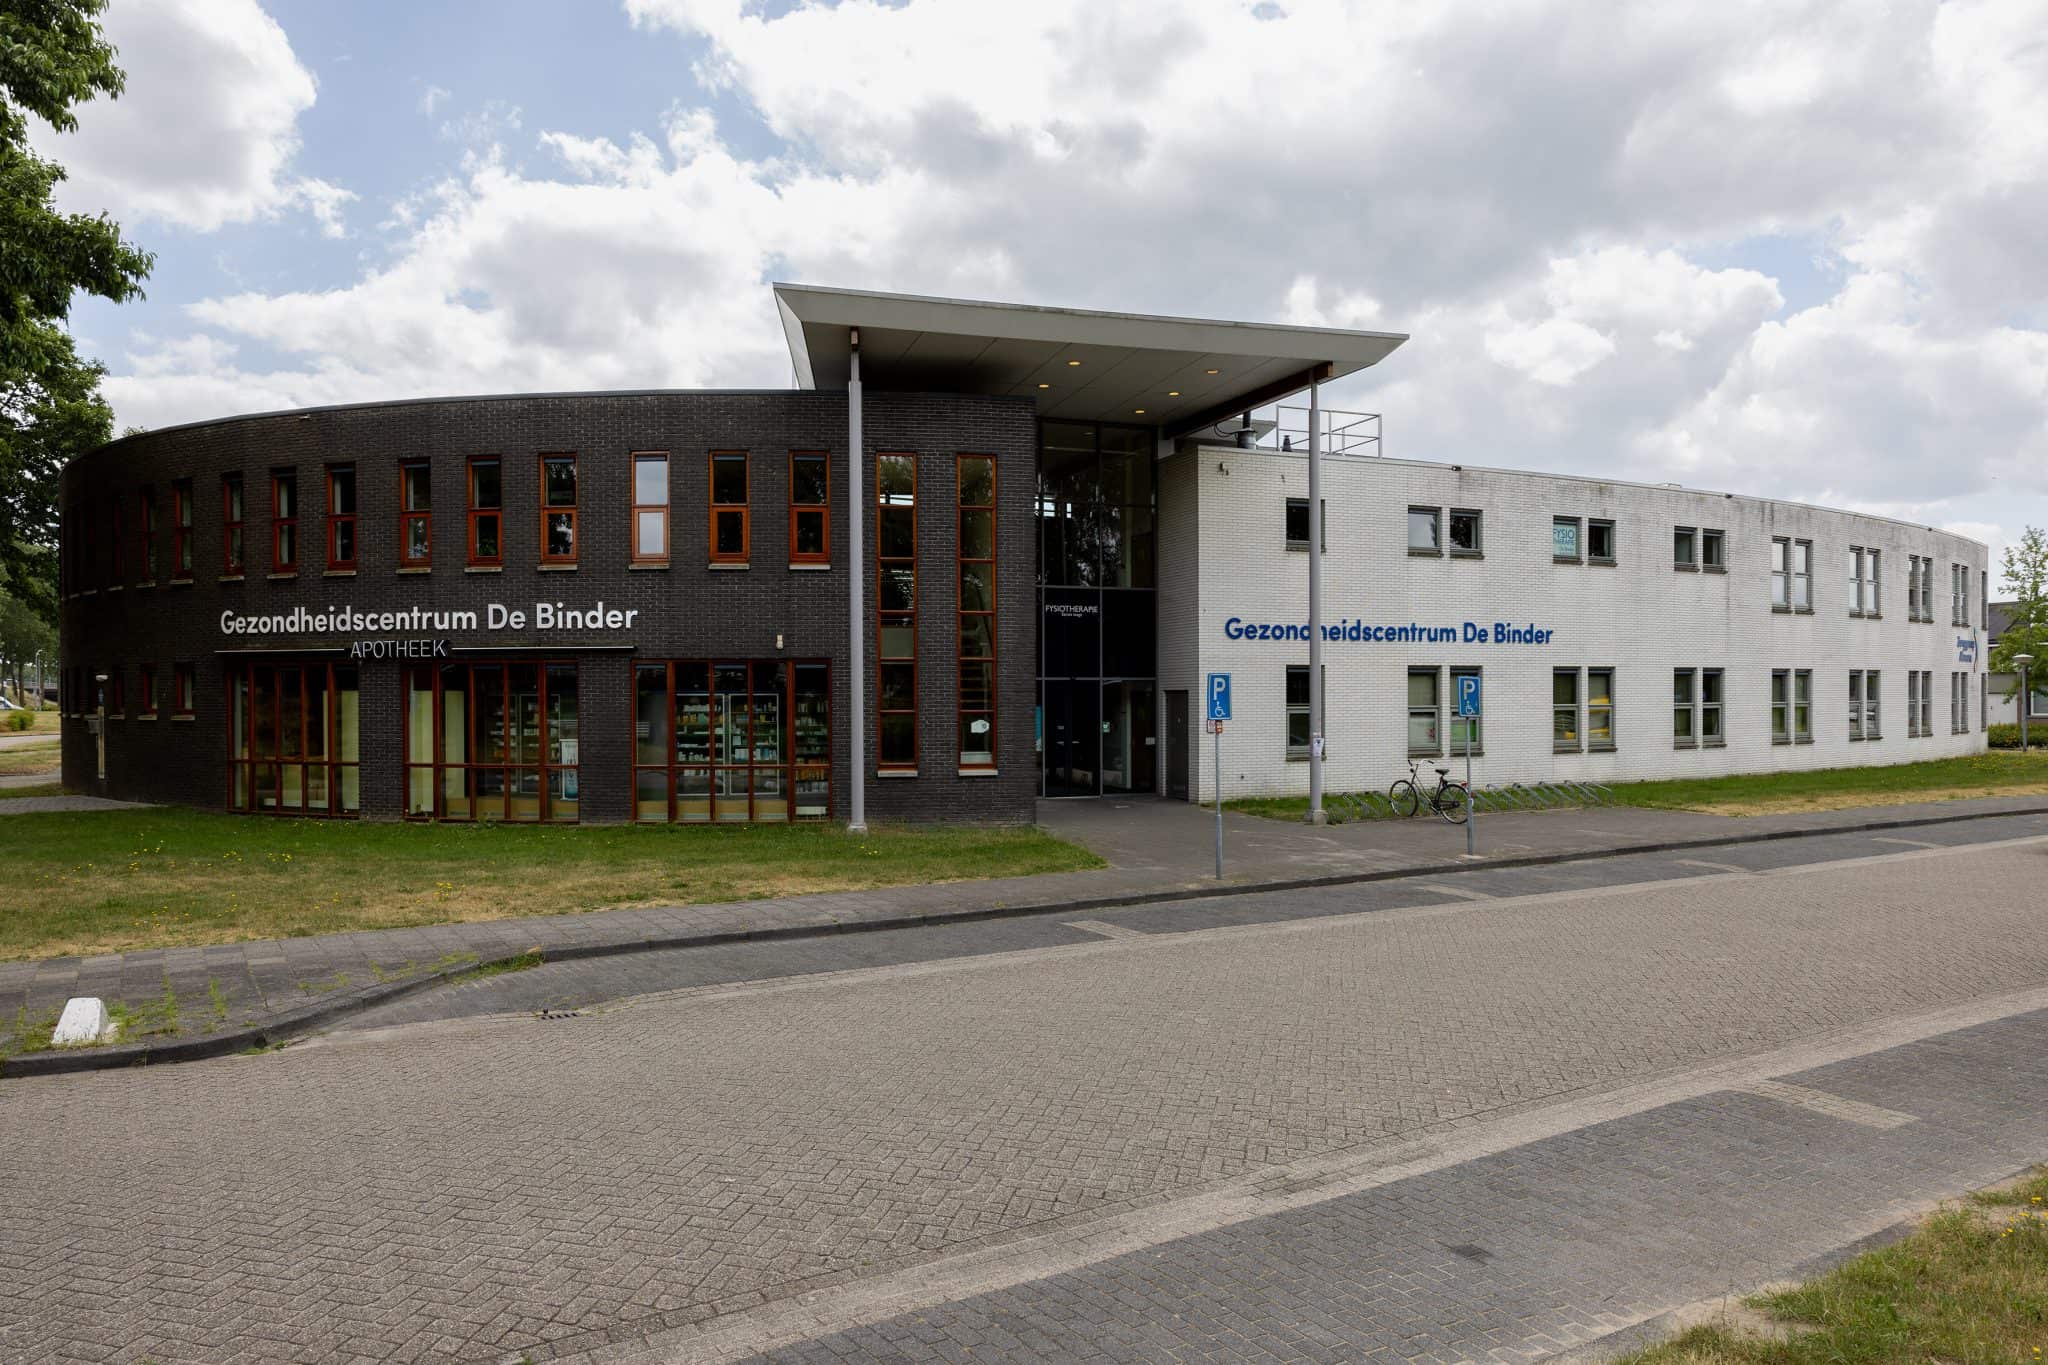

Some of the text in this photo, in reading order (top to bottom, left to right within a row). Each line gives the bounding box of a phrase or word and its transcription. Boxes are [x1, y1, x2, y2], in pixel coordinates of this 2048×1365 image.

[1553, 528, 1575, 540] FYSIO
[220, 601, 639, 634] Gezondheidscentrum De Binder
[1045, 605, 1098, 613] FYSIOTHERAPIE
[1463, 621, 1488, 643] De
[1494, 622, 1553, 644] Binder
[350, 640, 447, 658] APOTHEEK
[1213, 677, 1226, 700] P
[1463, 680, 1476, 700] P
